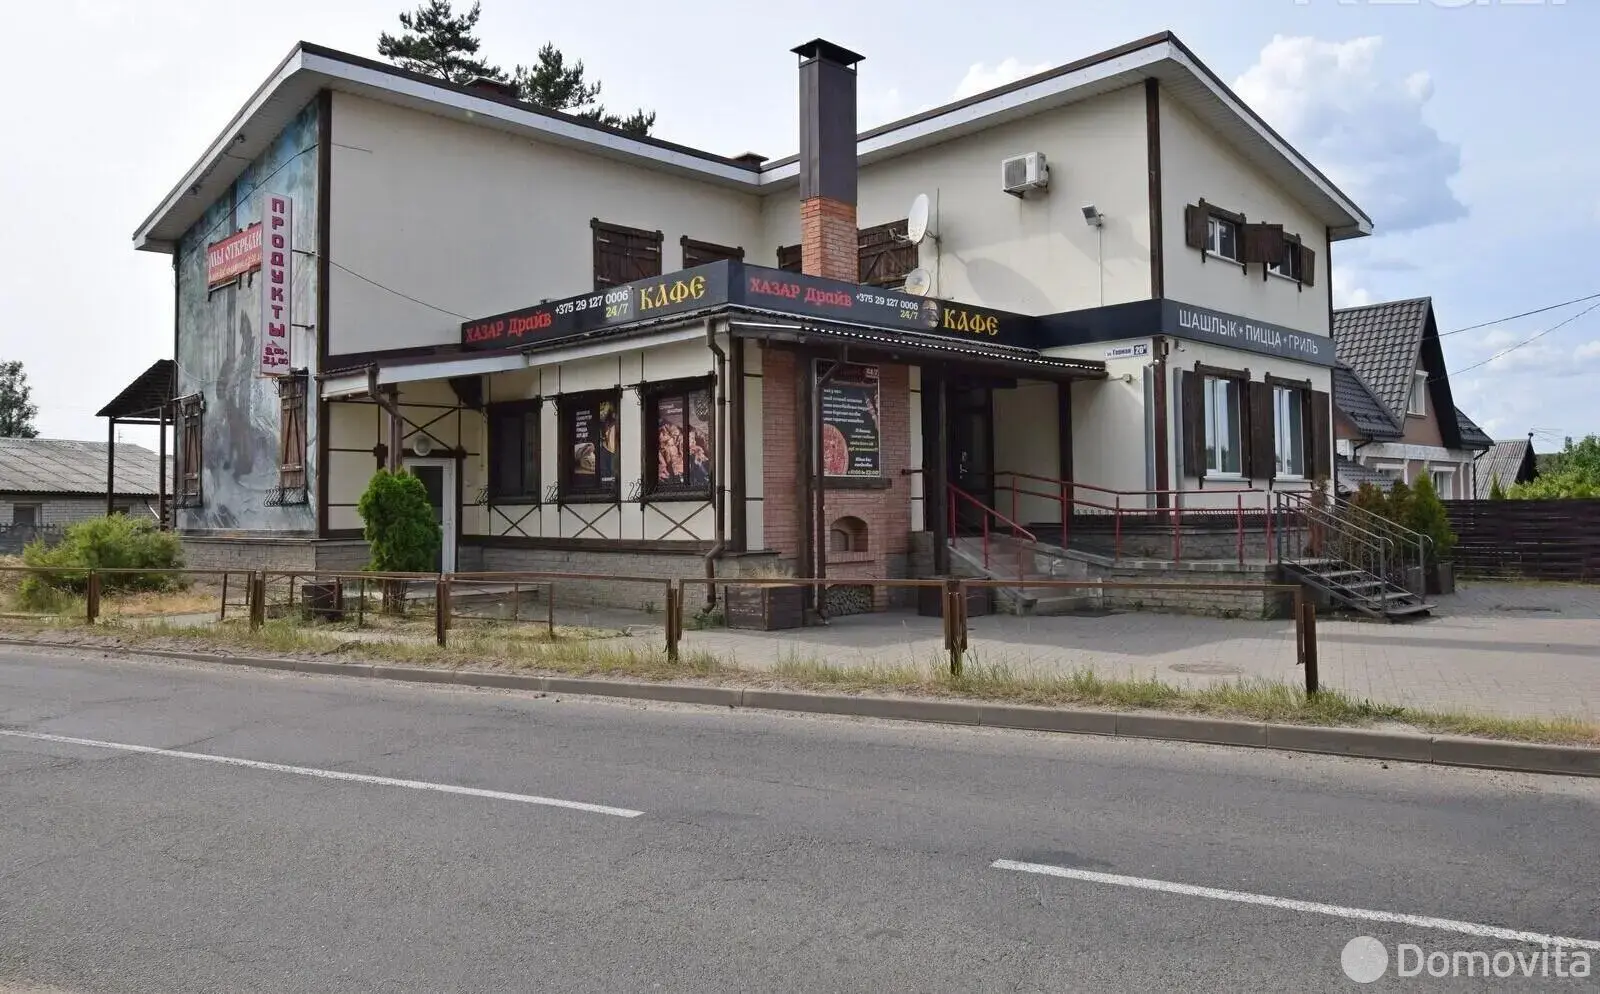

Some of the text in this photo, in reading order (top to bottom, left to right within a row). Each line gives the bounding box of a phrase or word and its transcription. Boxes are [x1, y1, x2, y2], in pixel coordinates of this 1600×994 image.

[268, 197, 285, 338] ПРОДУКТЫ
[555, 290, 629, 315] +375 29 127 0006
[639, 275, 706, 311] КАФЕ
[749, 276, 852, 306] ХАЗАР Драйв
[856, 293, 918, 310] +375 29 127 0006
[605, 303, 629, 318] 24/7
[900, 310, 918, 320] 24/7
[943, 307, 999, 336] КАФЕ
[465, 310, 552, 342] ХАЗАР Драйв
[1179, 309, 1319, 354] ШАШЛЫК ПИЦЦА ГРИЛЬ
